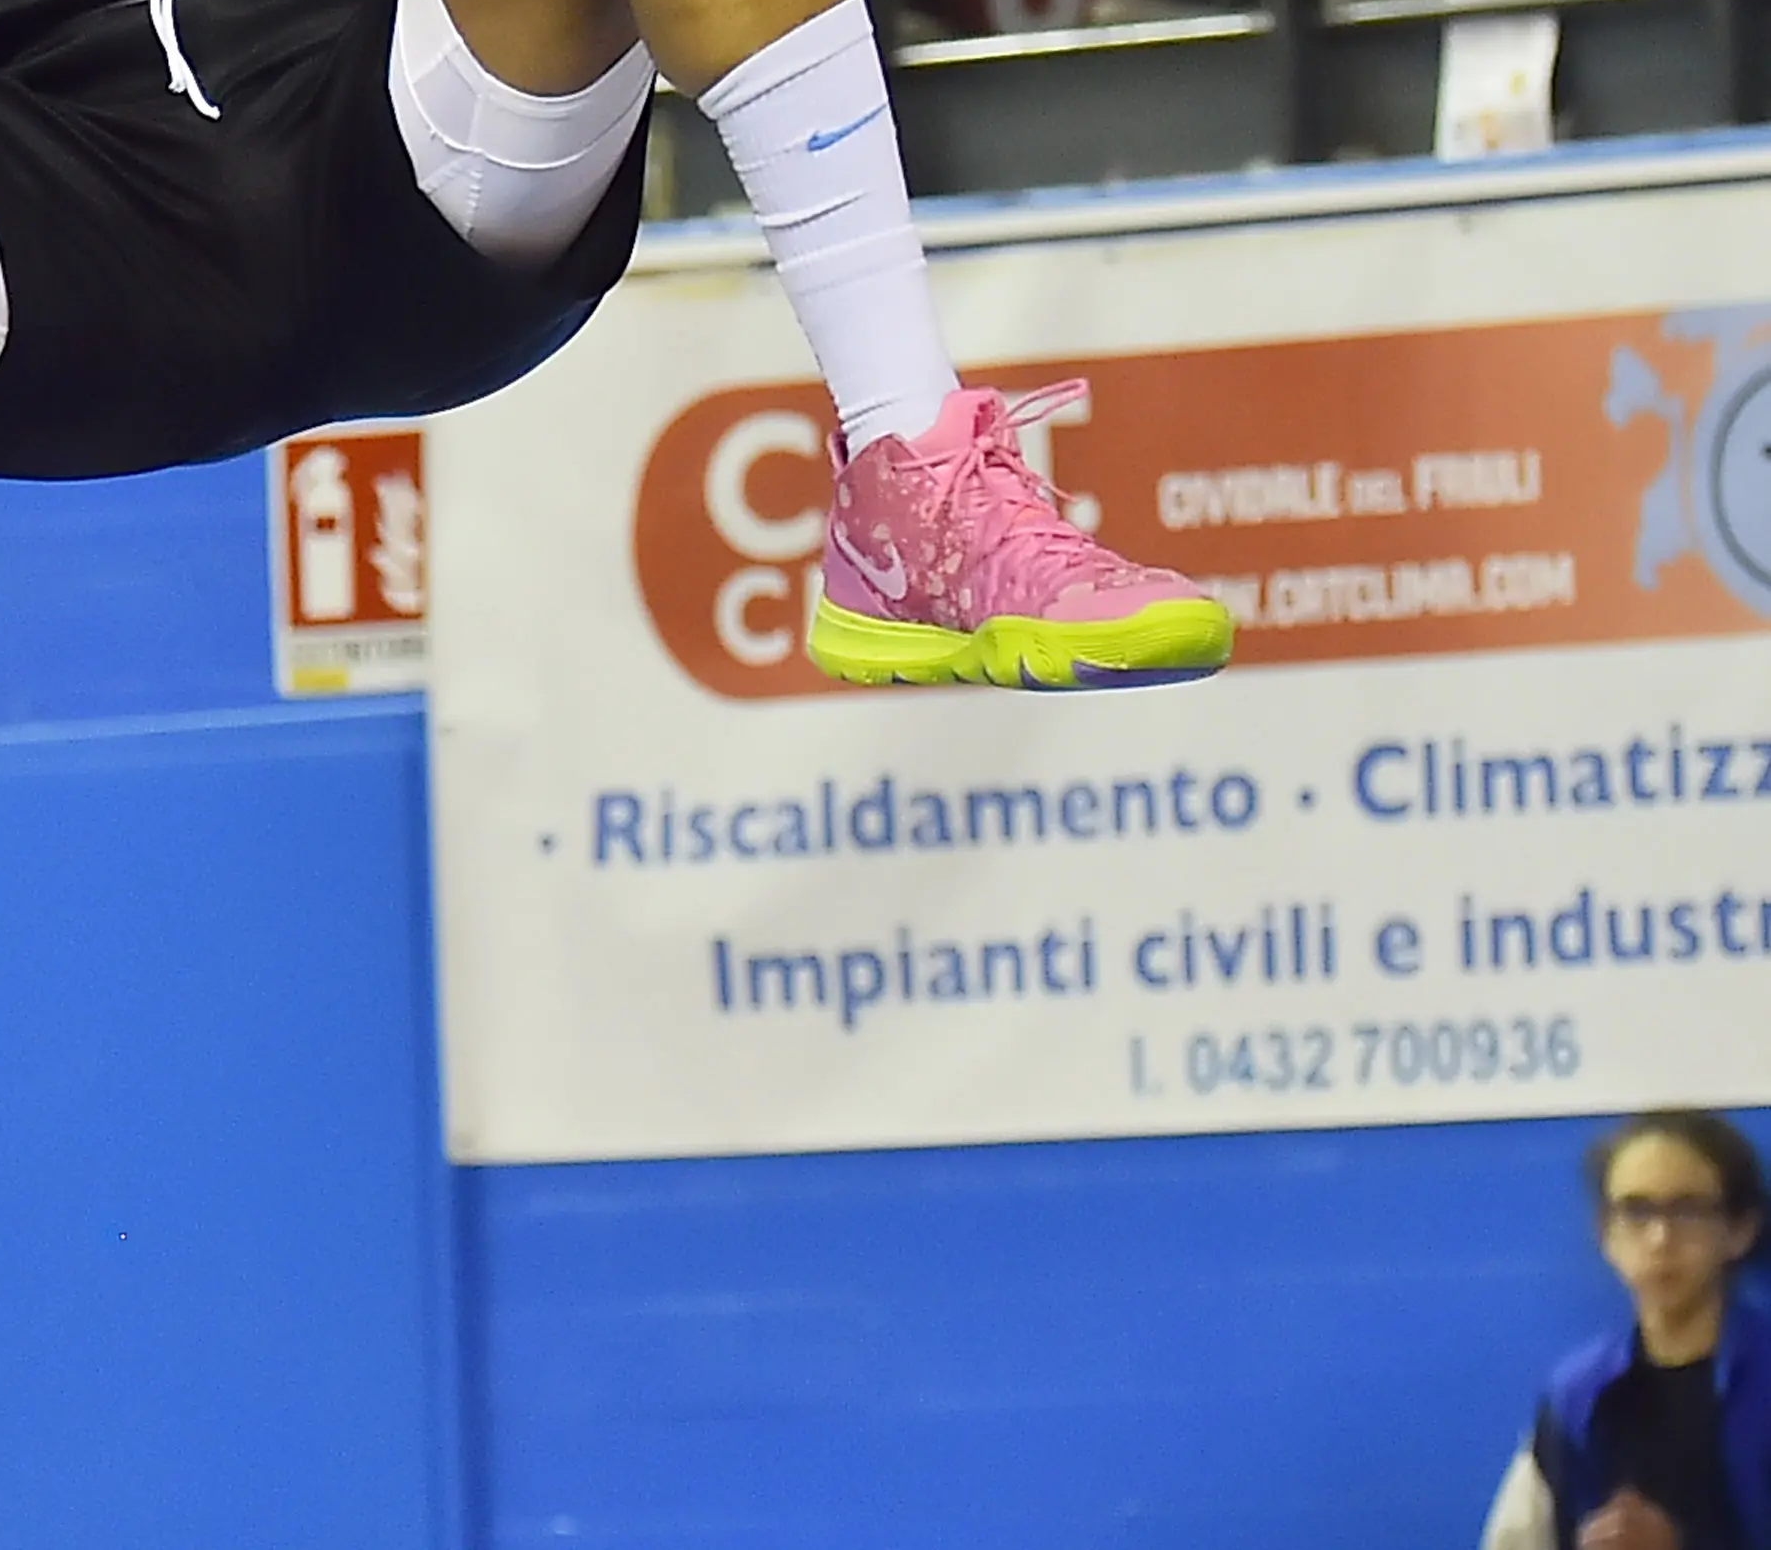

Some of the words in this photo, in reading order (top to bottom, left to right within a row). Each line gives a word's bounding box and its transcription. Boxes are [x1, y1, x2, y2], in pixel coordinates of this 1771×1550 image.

[592, 768, 1260, 866] Riscaldamento
[712, 916, 1095, 1030] Impianti
[1134, 900, 1337, 986] civili
[1374, 916, 1423, 975] e
[1185, 1026, 1334, 1095] 0432
[1351, 1013, 1581, 1086] 700936
